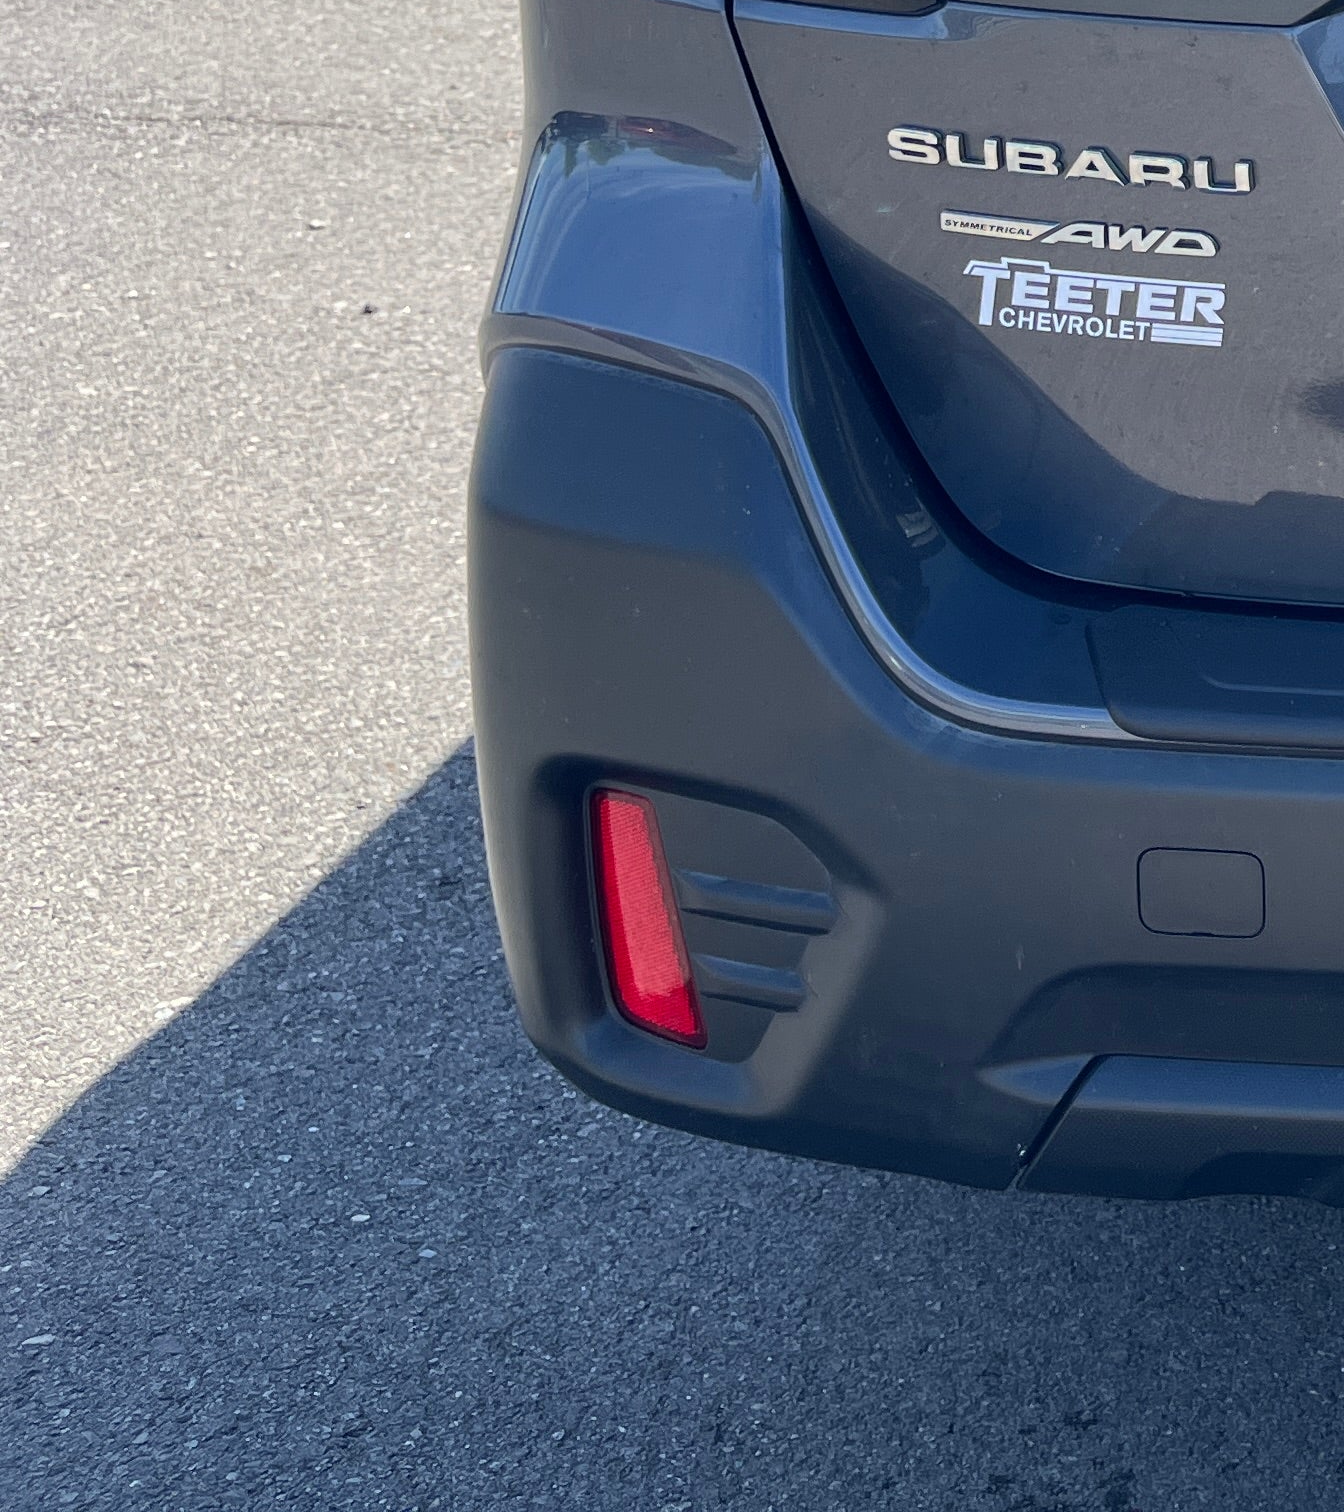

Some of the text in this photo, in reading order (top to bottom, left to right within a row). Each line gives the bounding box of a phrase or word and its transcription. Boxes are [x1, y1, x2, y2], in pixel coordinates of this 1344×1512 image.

[886, 125, 1256, 194] SUBARU
[943, 218, 1220, 257] SYMMETRICAL AWD
[965, 261, 1226, 326] TEETER
[999, 307, 1151, 341] CHEVROLET
